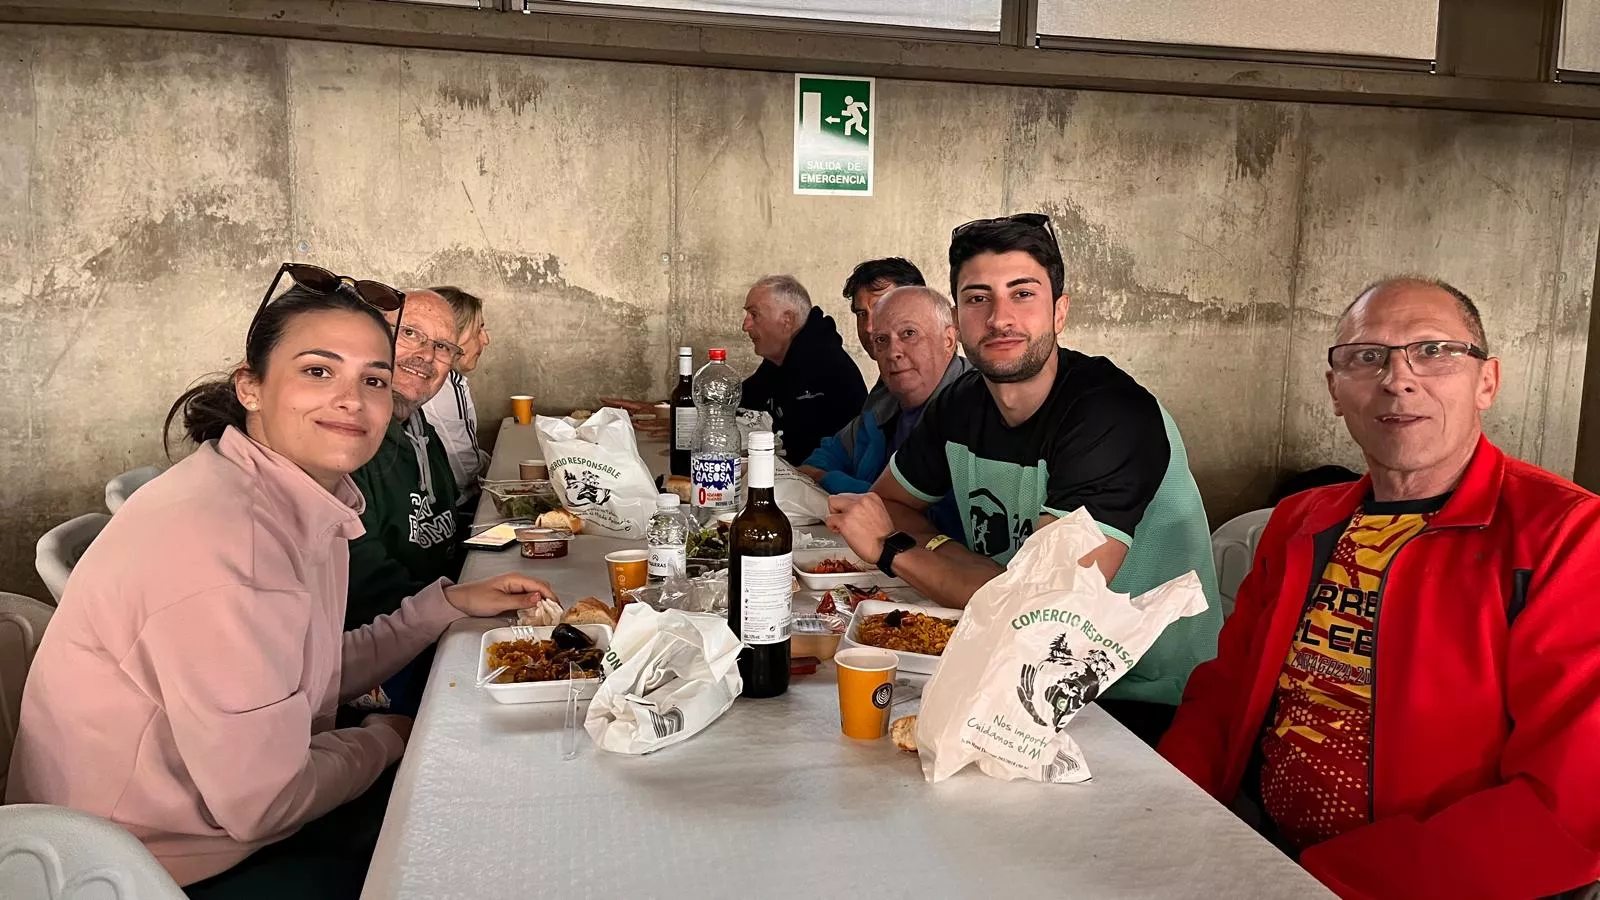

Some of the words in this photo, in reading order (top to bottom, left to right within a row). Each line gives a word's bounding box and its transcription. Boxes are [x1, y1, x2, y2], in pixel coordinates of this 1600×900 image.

[807, 161, 841, 171] SALIDA
[847, 162, 862, 172] DE
[800, 173, 866, 185] EMERGENCIA
[567, 456, 621, 479] RESPONSABLE
[693, 459, 732, 473] GASEOSA
[695, 471, 731, 483] GASOSA
[1011, 609, 1081, 630] COMERCIO
[1080, 620, 1135, 669] RESPONSA
[993, 714, 1012, 732] Nos
[967, 717, 1014, 749] Cuidamos
[1017, 744, 1029, 754] el
